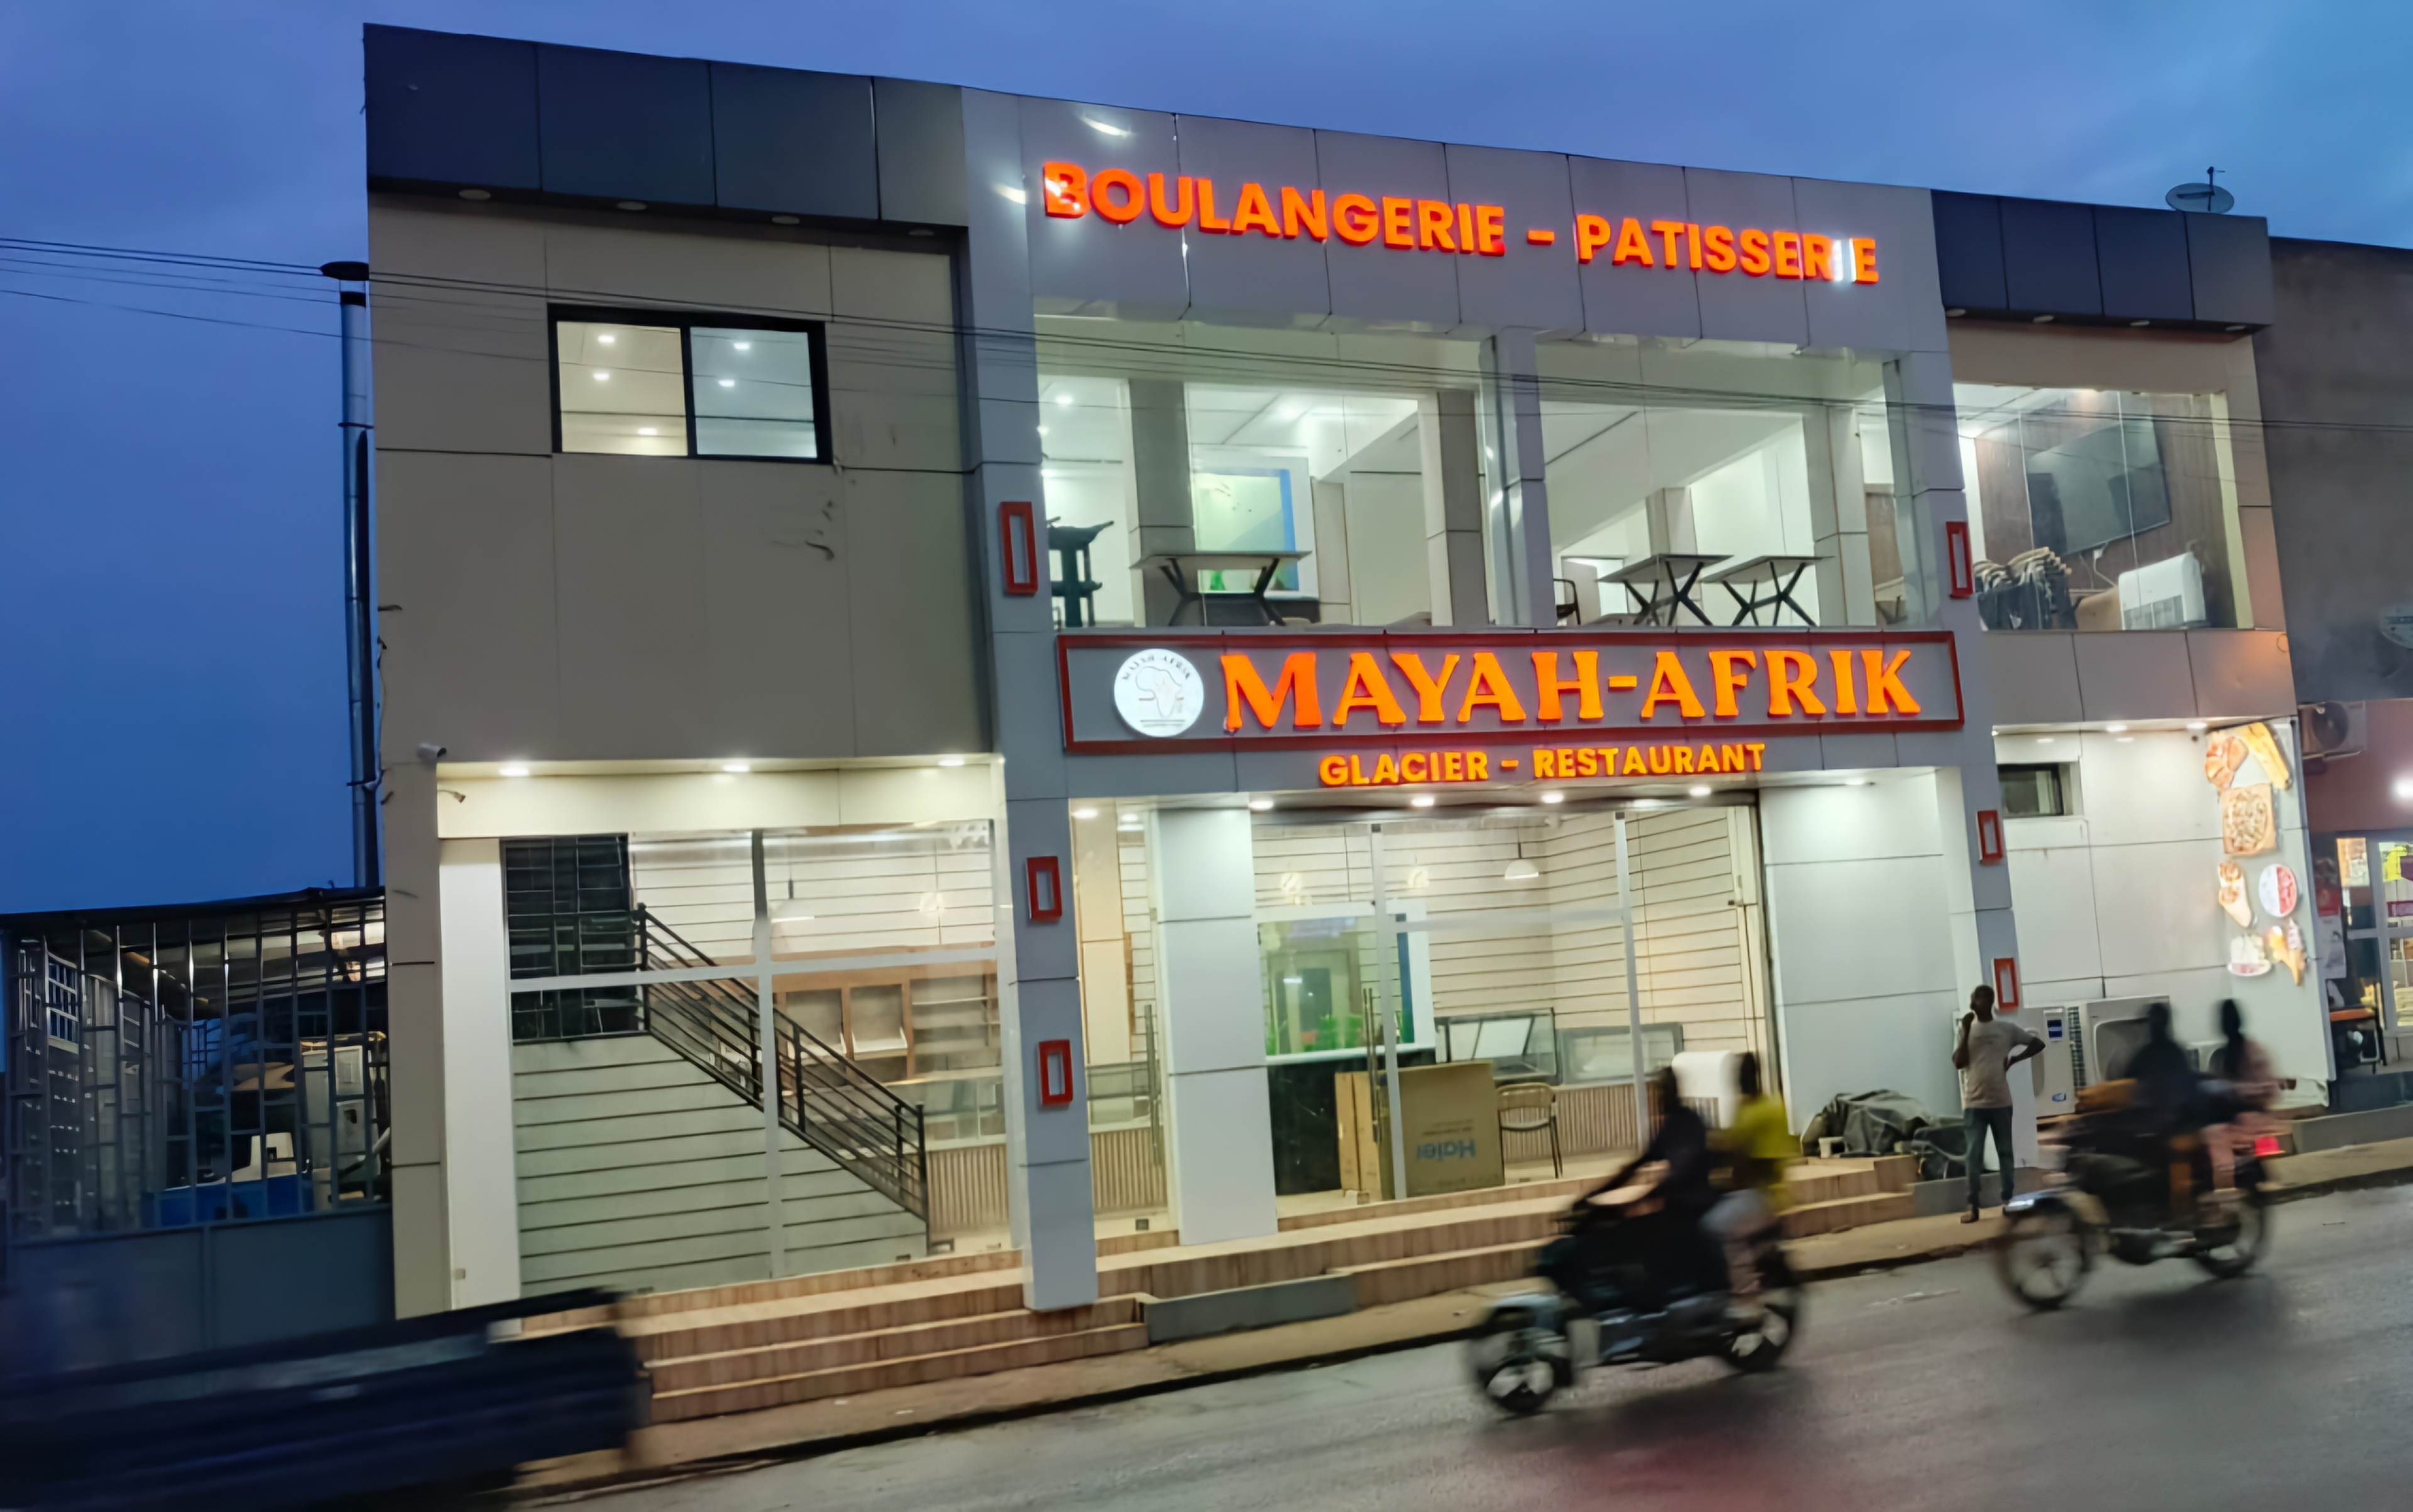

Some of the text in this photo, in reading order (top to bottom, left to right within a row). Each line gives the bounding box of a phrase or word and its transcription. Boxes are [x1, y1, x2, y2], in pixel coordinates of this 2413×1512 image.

[1042, 161, 1506, 256] BOULANGERIE
[1575, 214, 1880, 285] PATISSERIE
[1221, 649, 1922, 733] MAYAH-AFRIK
[1318, 750, 1488, 787] GLACIER
[1532, 742, 1765, 779] RESTAURANT
